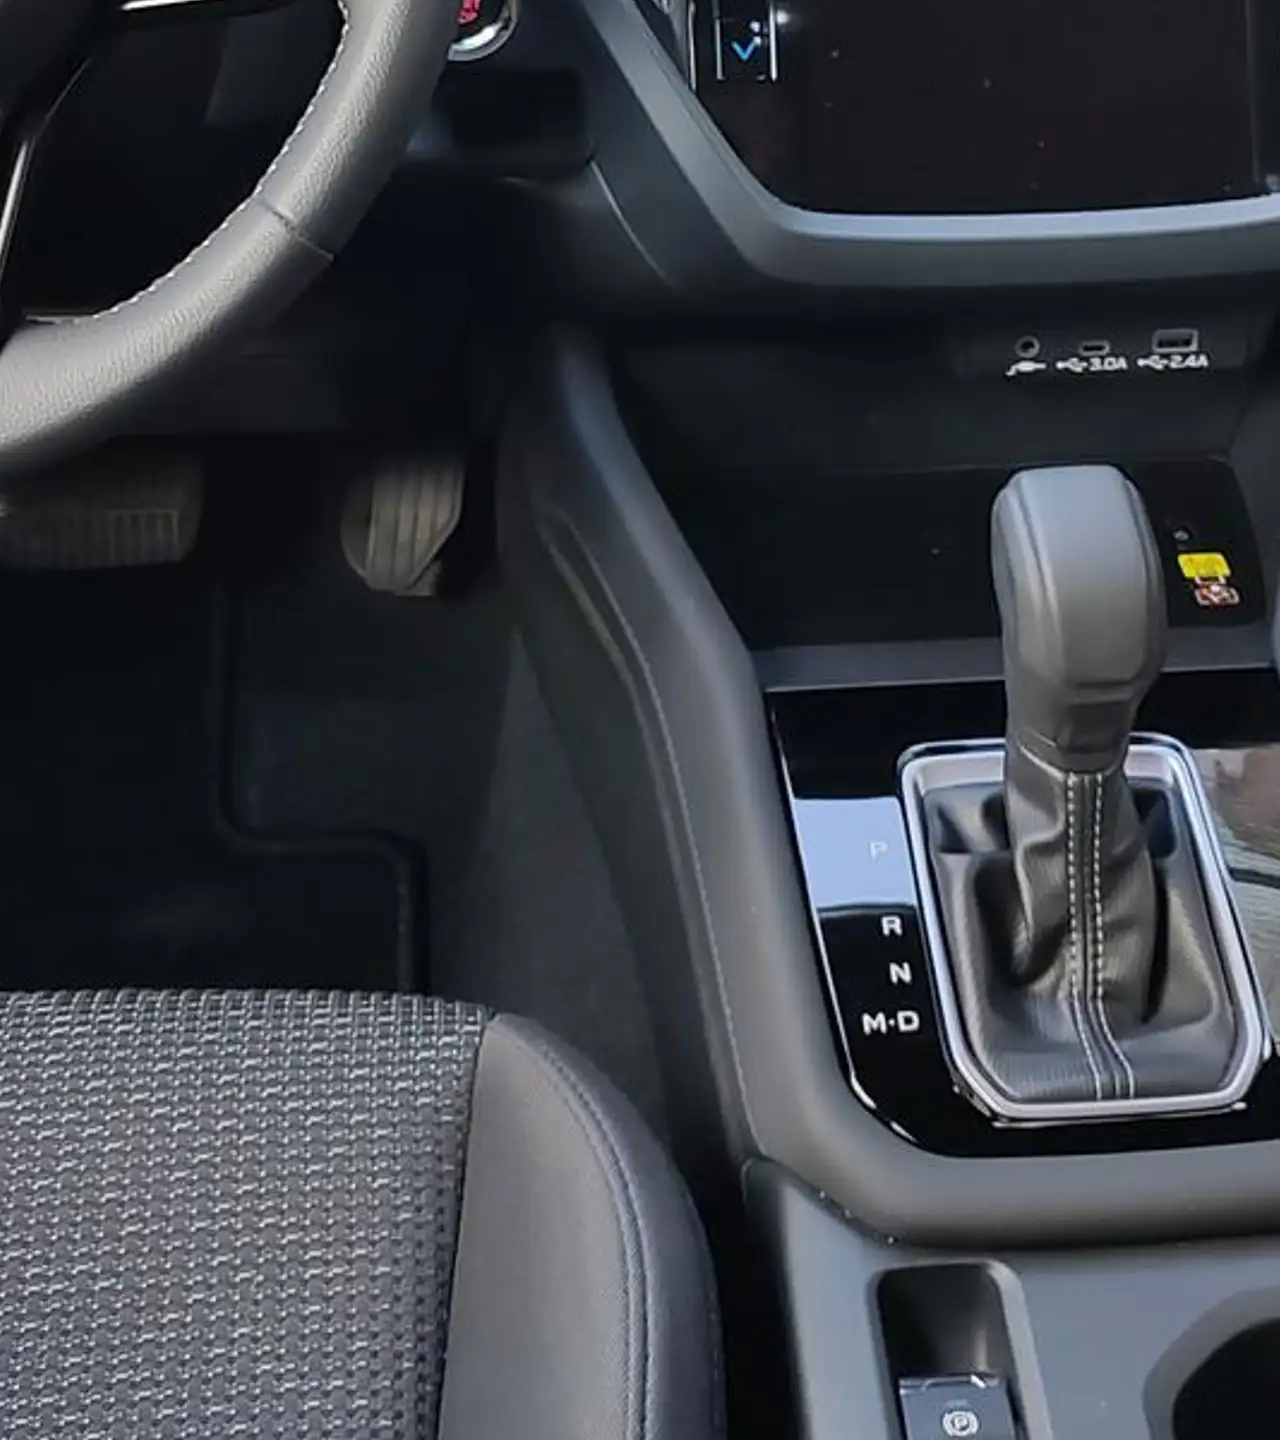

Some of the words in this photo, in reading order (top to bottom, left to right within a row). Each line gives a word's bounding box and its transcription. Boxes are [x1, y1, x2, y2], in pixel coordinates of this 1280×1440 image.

[870, 840, 888, 860] P
[881, 915, 903, 937] R
[889, 961, 913, 984] N
